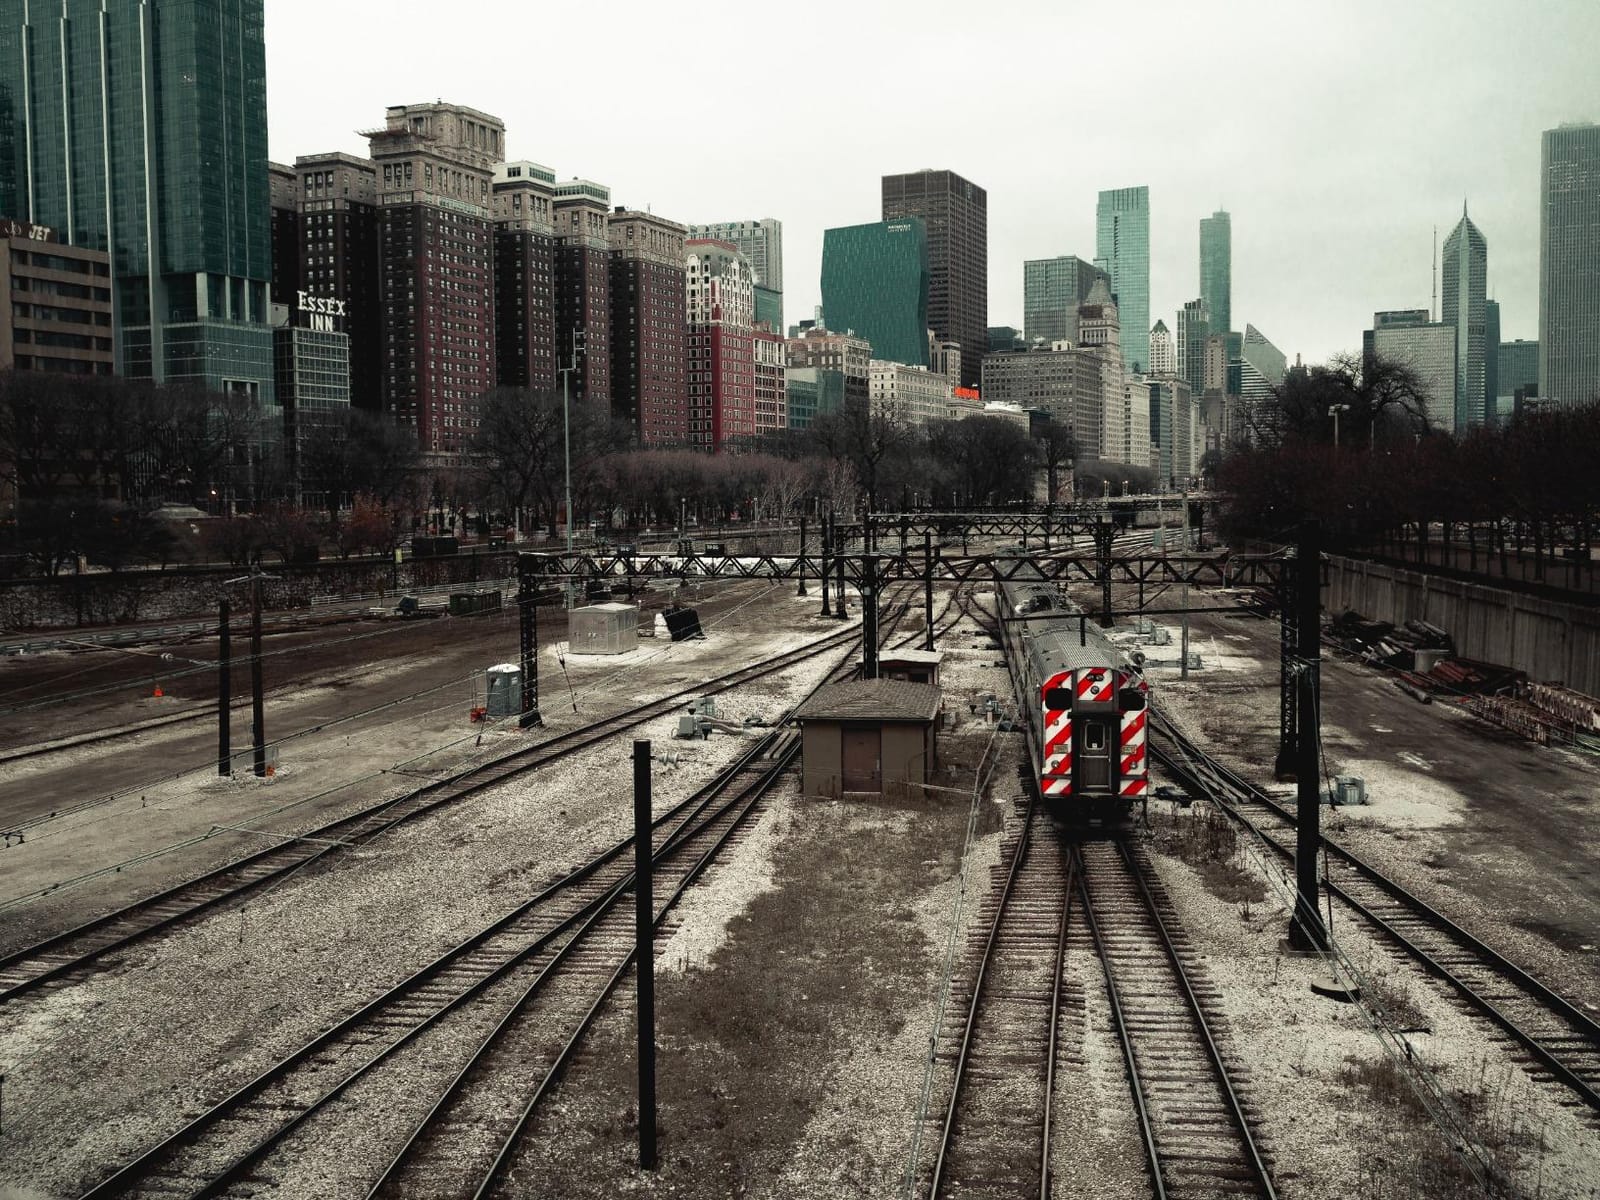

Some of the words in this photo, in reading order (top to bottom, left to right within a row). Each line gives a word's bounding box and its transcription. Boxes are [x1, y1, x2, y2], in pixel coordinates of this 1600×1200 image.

[28, 225, 51, 242] JET
[296, 290, 346, 316] ESSEX
[310, 313, 333, 332] INN
